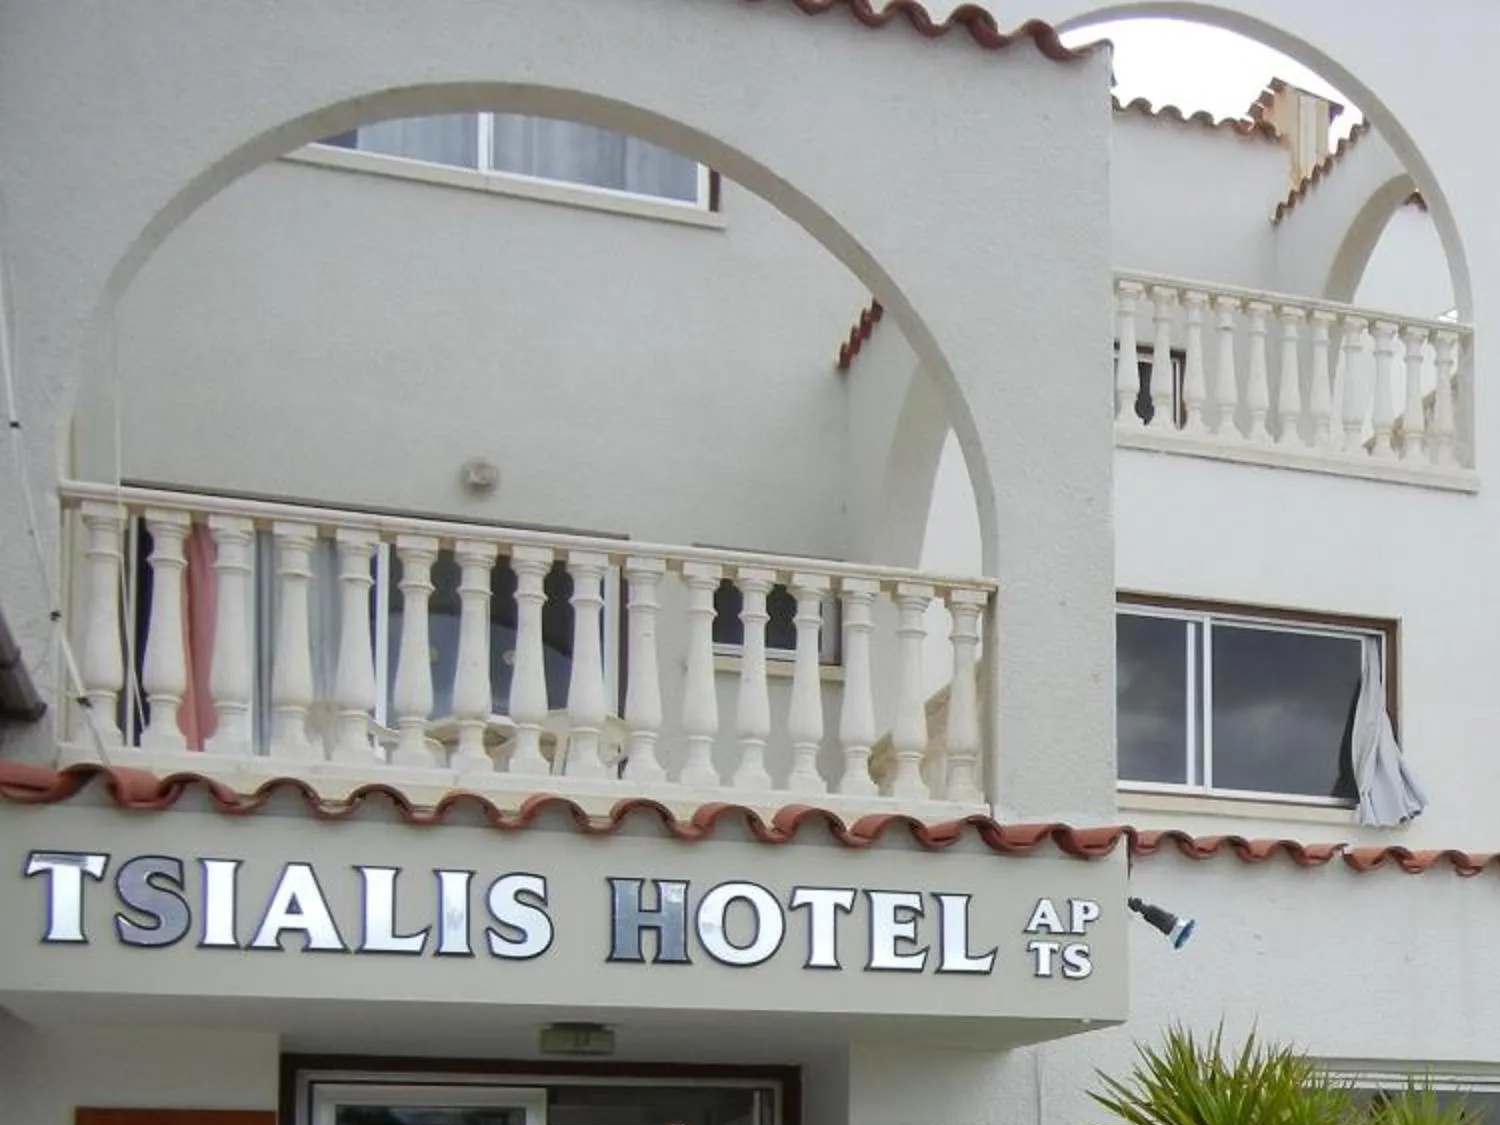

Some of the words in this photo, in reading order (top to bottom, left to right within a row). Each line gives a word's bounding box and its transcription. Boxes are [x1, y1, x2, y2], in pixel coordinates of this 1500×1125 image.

[23, 849, 554, 960] TSIALIS
[606, 876, 997, 975] HOTEL
[1022, 896, 1100, 936] AP
[1028, 939, 1093, 980] TS
